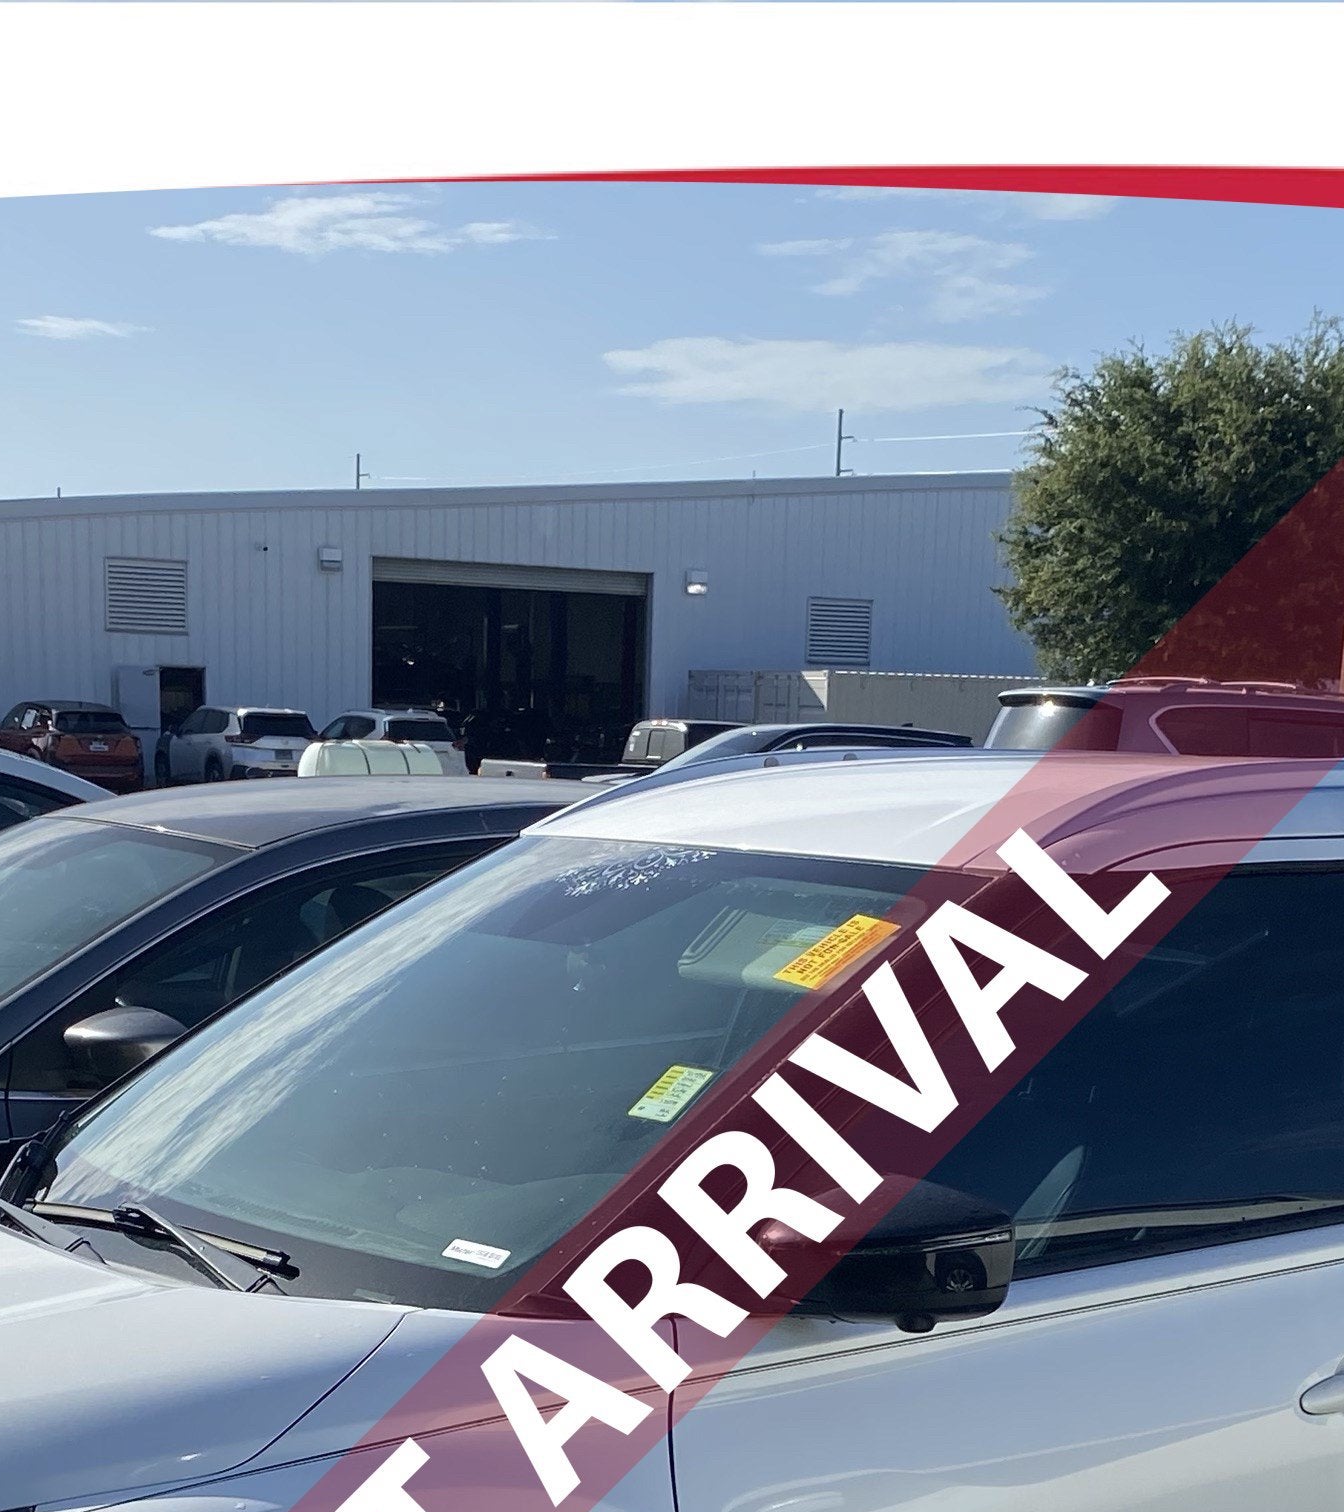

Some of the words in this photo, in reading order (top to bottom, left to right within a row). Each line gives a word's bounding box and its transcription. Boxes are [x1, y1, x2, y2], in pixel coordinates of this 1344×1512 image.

[782, 957, 809, 975] THIS
[805, 927, 848, 957] VEHICLE
[818, 943, 839, 959] FOR
[837, 926, 865, 946] SALE
